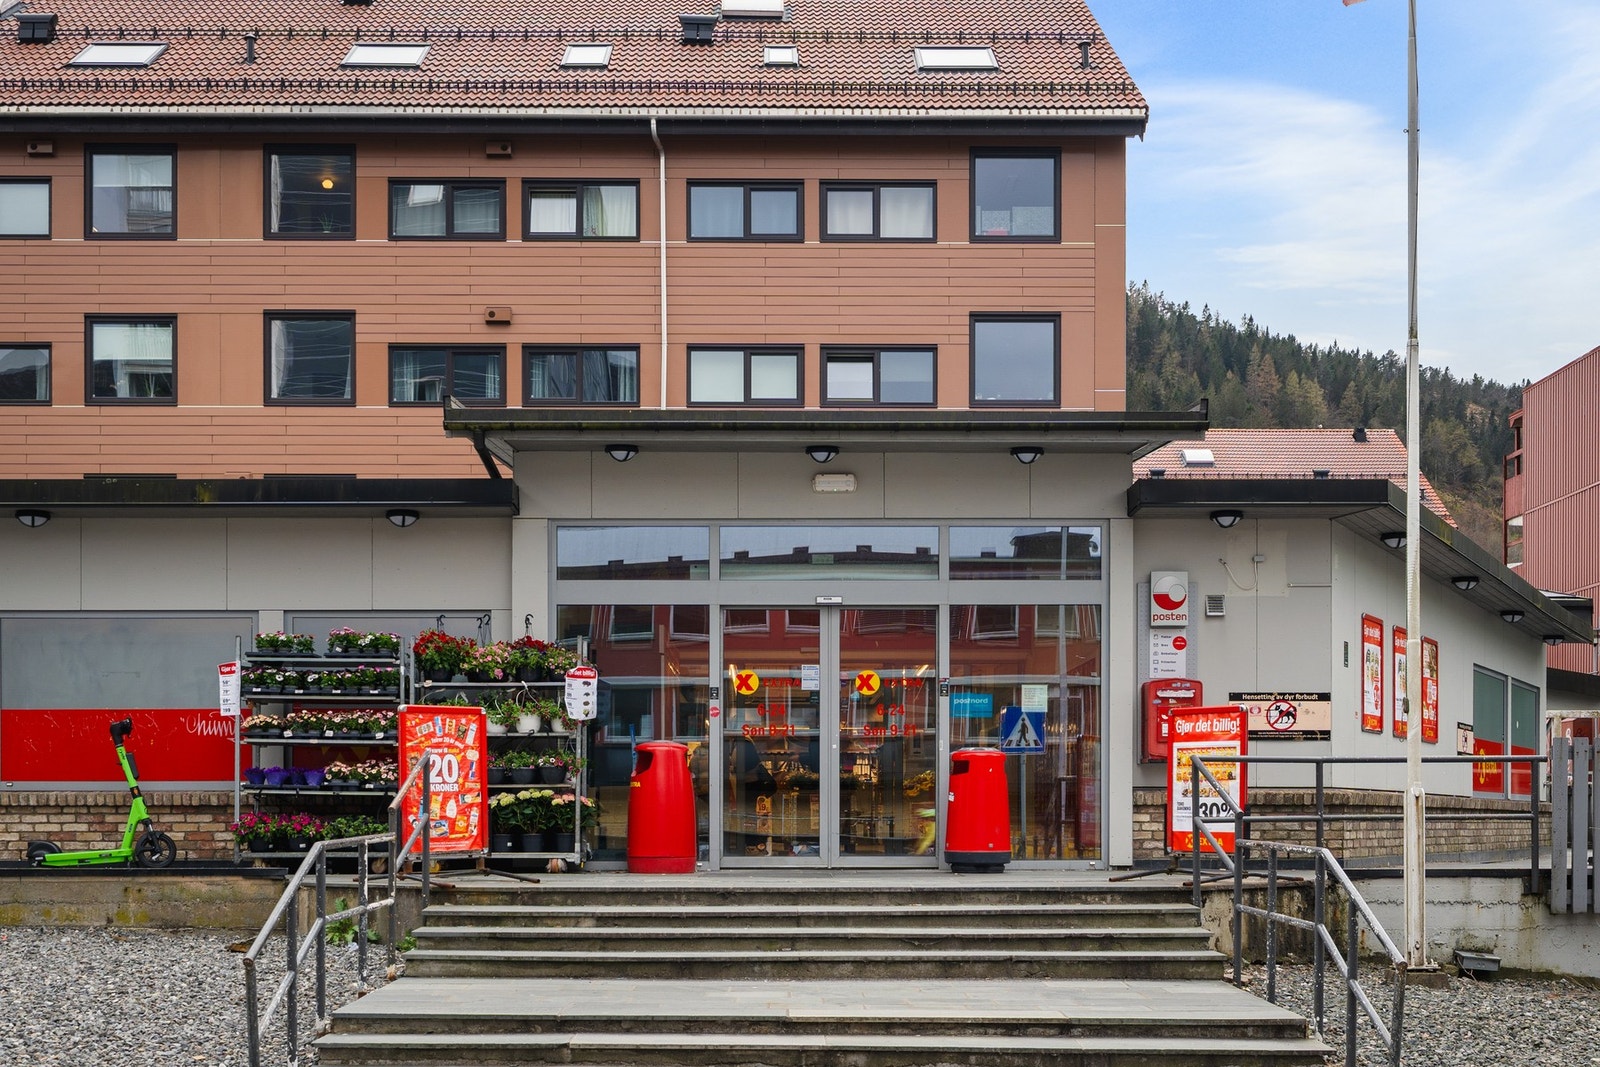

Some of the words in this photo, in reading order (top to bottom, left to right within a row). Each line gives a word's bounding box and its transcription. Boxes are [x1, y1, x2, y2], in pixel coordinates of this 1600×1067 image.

[1152, 612, 1187, 622] posten
[763, 678, 801, 687] EXTRA
[884, 678, 922, 687] EXTRA
[1242, 693, 1275, 701] Hensetting
[876, 703, 905, 716] 6-24
[742, 724, 764, 736] Søn
[863, 724, 886, 736] Søn
[1175, 719, 1194, 735] Gjør
[1195, 719, 1211, 732] det
[1212, 718, 1240, 734] billig!
[429, 754, 459, 783] 20
[430, 783, 459, 792] KRONER
